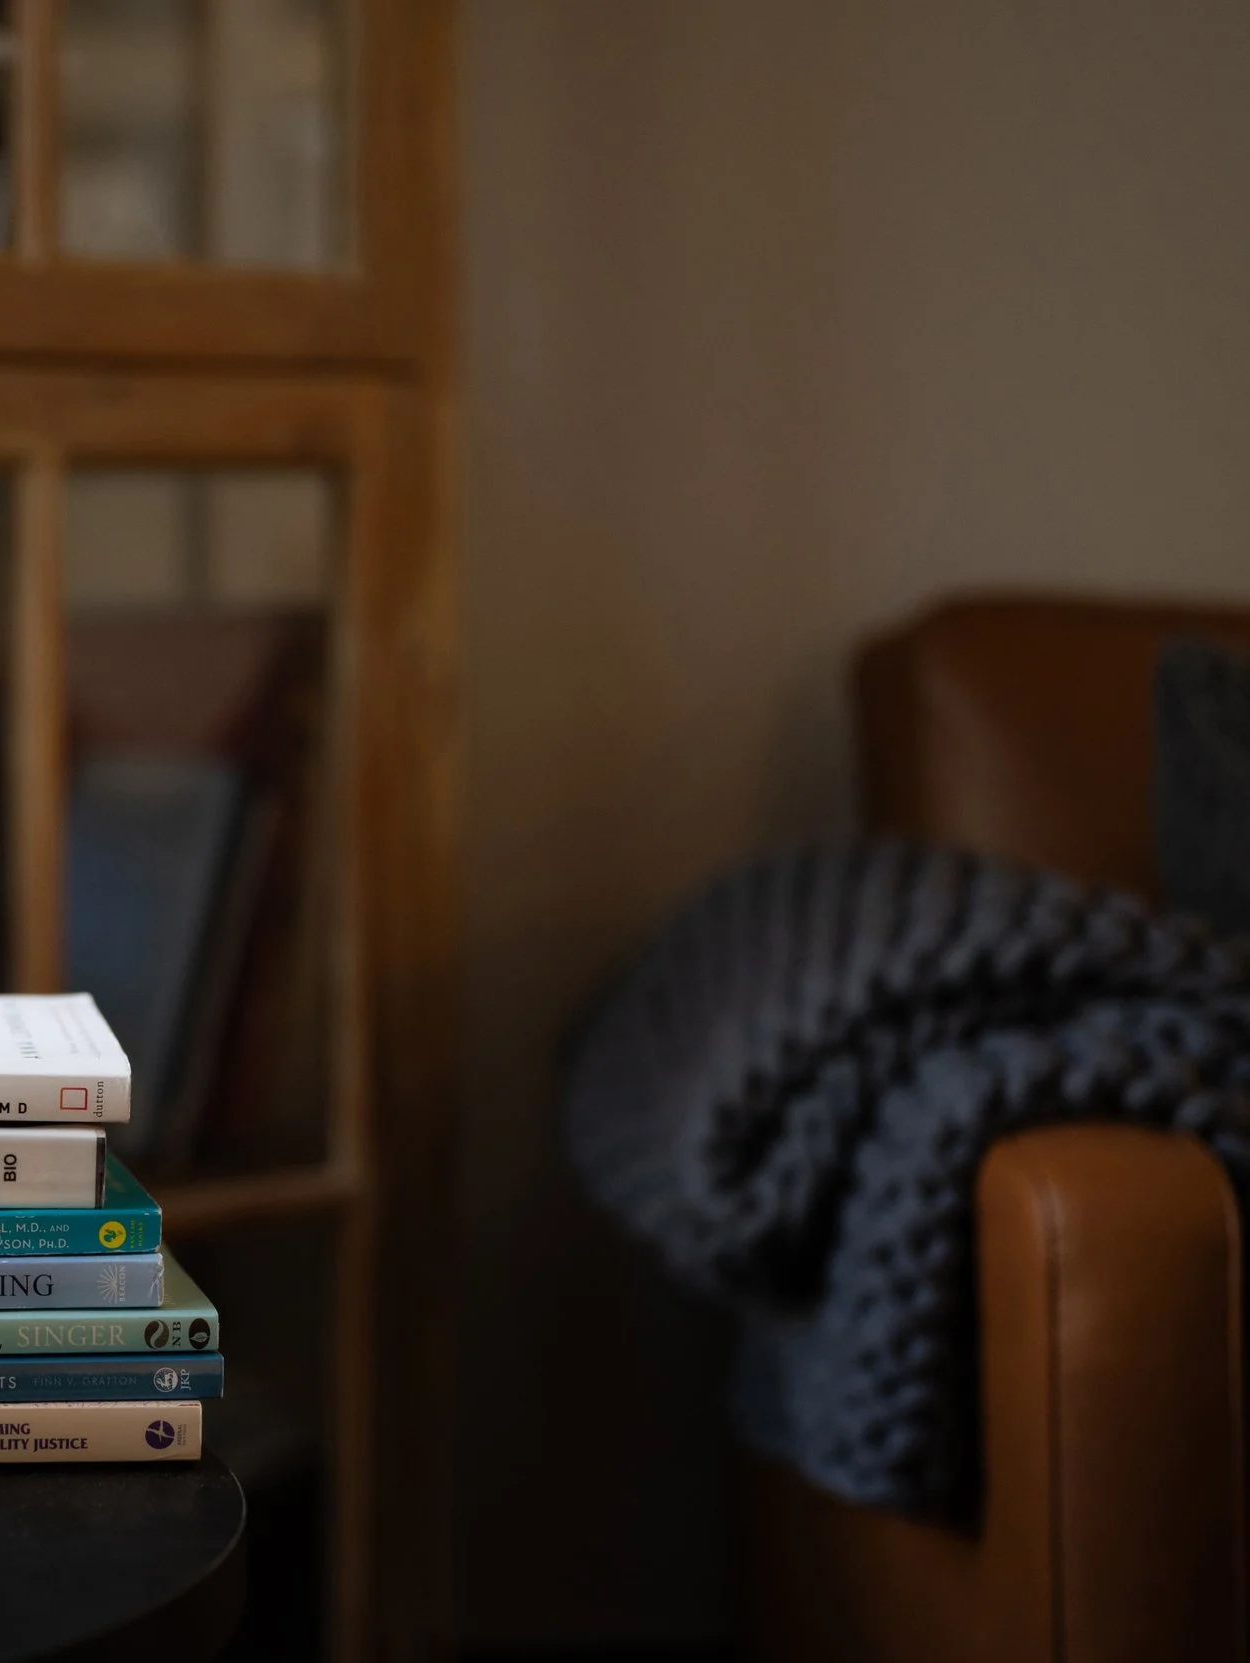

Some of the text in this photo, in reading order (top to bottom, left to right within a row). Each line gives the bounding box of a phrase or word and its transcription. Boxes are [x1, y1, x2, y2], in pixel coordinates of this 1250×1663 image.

[0, 1102, 28, 1114] MD
[93, 1080, 104, 1118] dutton
[3, 1153, 17, 1182] BIO
[16, 1223, 47, 1234] M.D.,
[50, 1224, 70, 1232] AND
[17, 1325, 126, 1347] SINGER
[33, 1376, 62, 1387] FINN
[82, 1376, 137, 1386] GRATTON
[180, 1369, 192, 1390] JKP
[33, 1437, 88, 1452] JUSTICE
